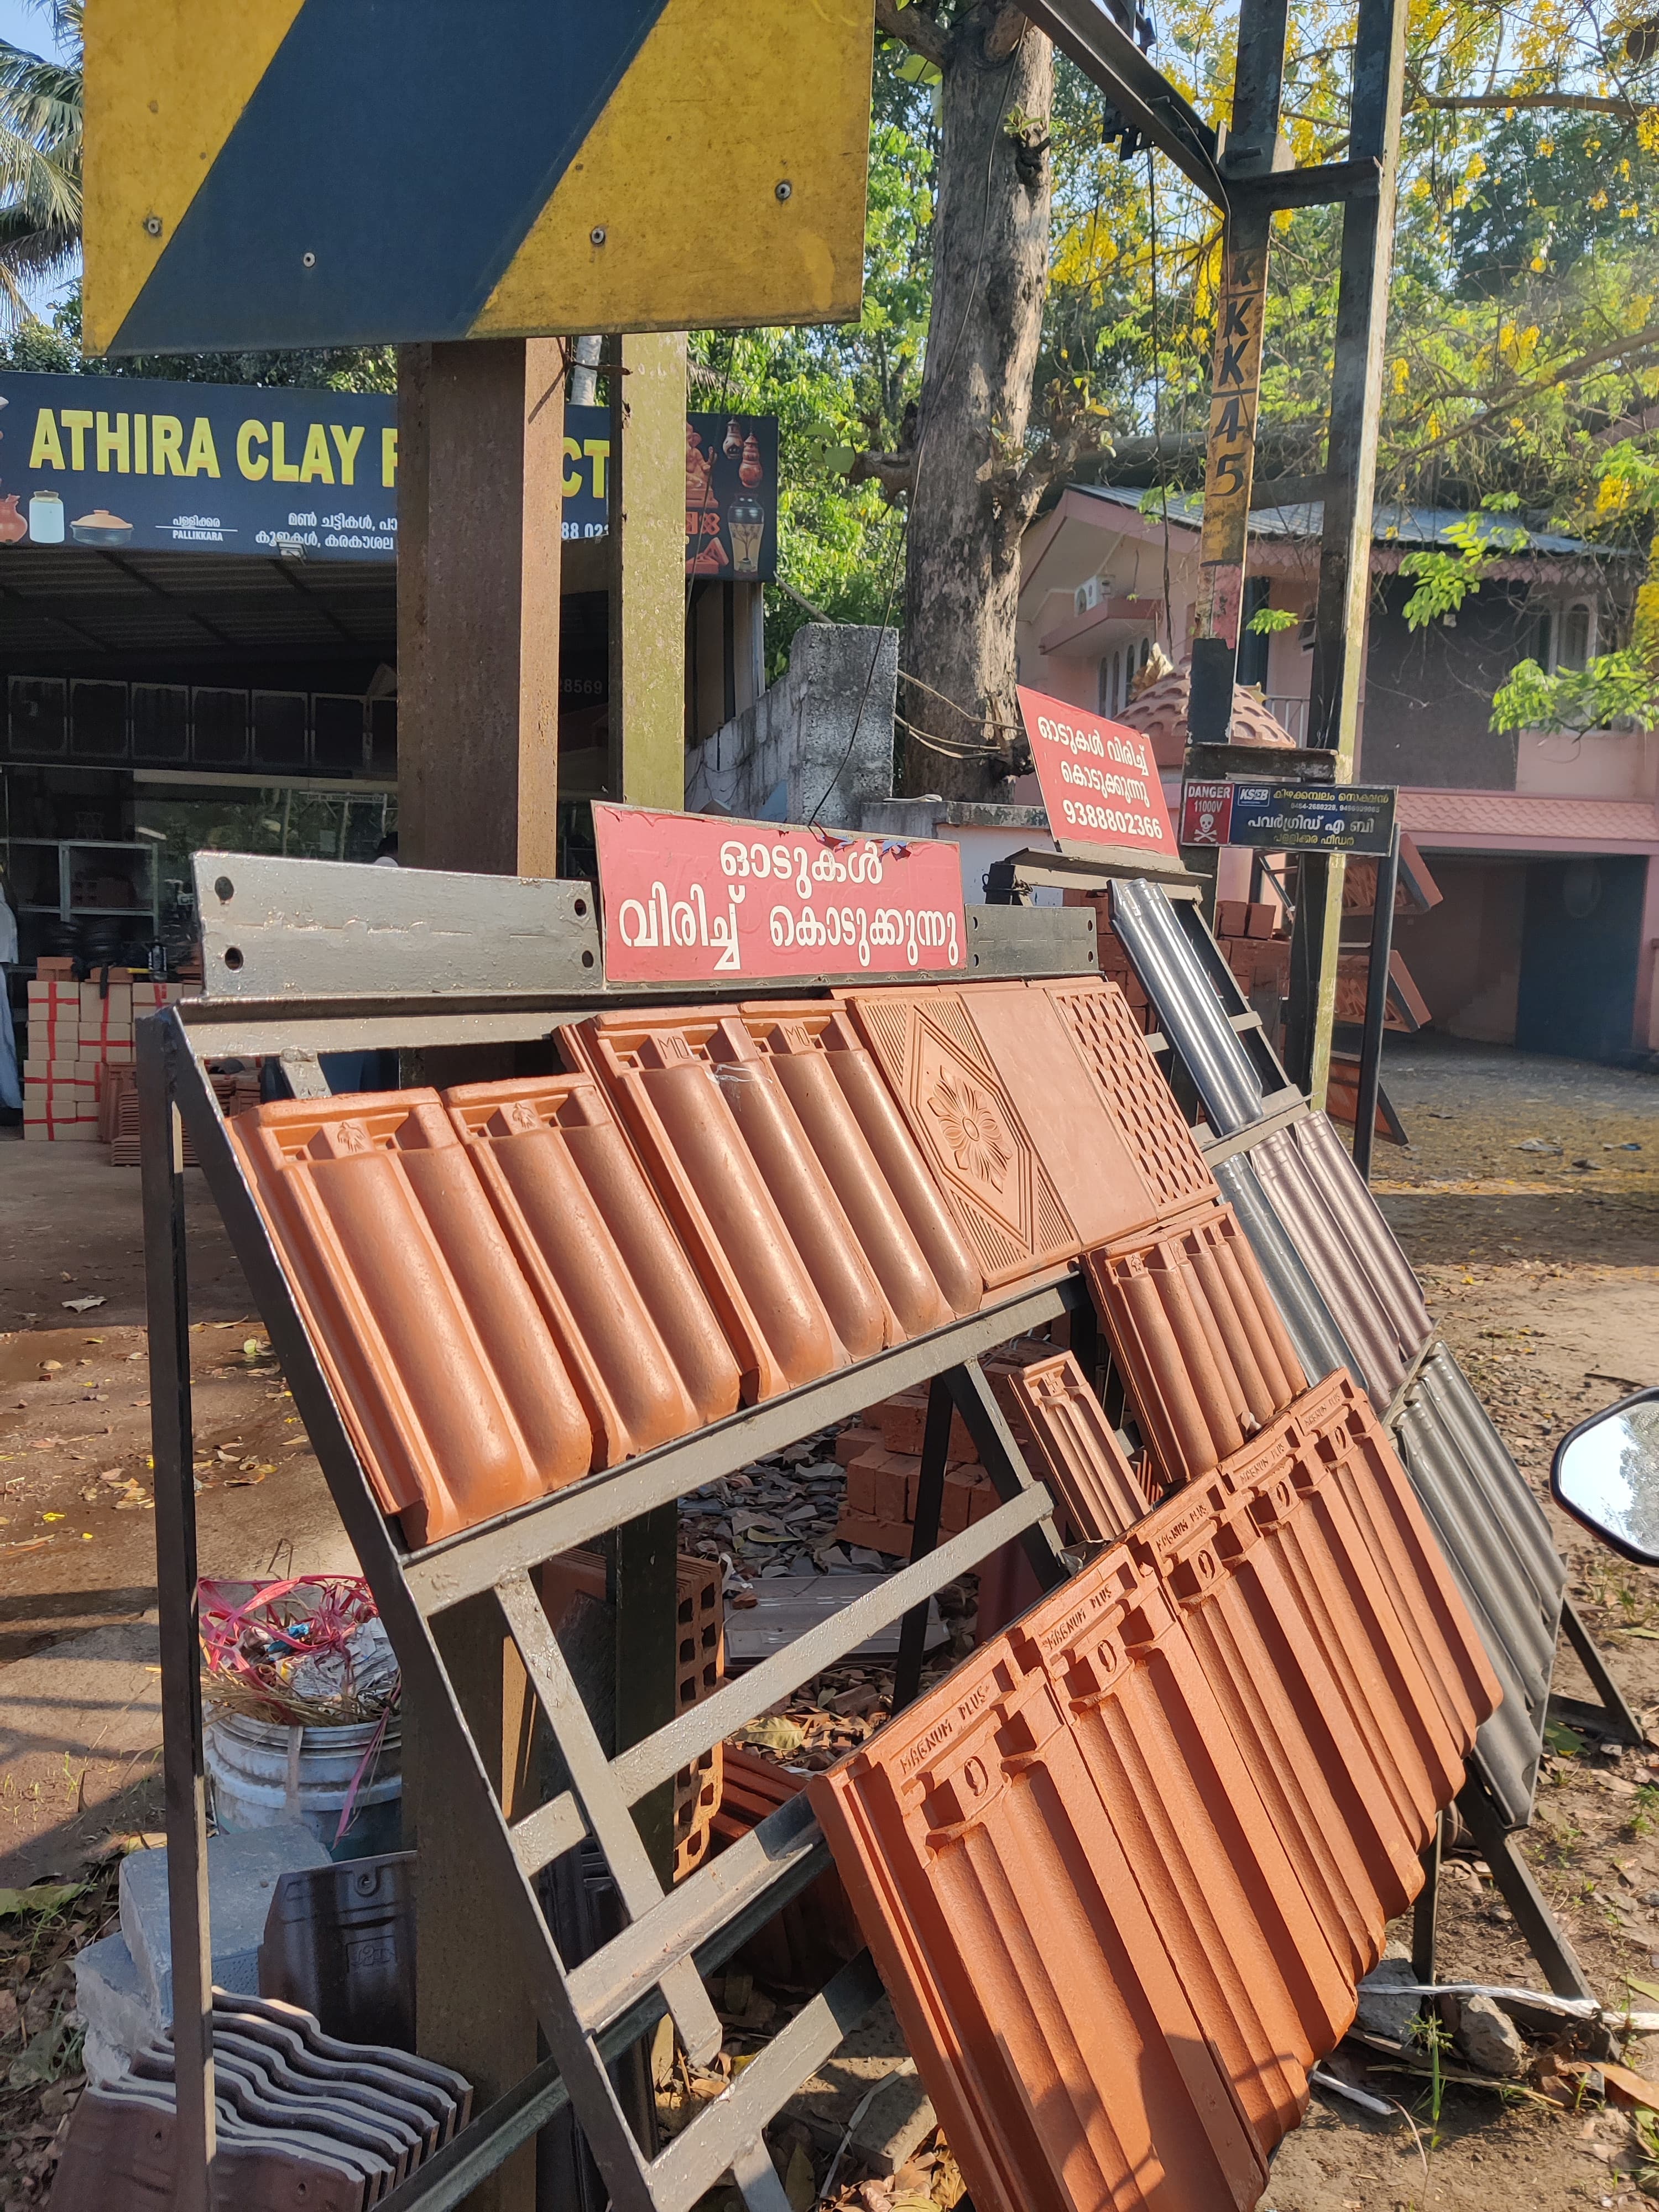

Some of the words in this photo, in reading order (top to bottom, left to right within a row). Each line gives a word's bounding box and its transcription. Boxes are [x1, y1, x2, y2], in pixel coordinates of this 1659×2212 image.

[29, 408, 221, 478] ATHIRA
[236, 419, 365, 486] CLAY
[173, 529, 223, 542] PALLIKKARA
[1038, 716, 1104, 758] ഓടുകൾ
[1107, 736, 1149, 776] വിരിച്ച്
[1061, 760, 1150, 808] കൊടുക്കുന്നു
[1188, 786, 1231, 799] DANGER
[1240, 789, 1269, 801] KSEB
[1063, 800, 1163, 839] 9388802366
[1194, 800, 1223, 813] 11000V
[1325, 819, 1345, 834] എ
[1350, 817, 1374, 833] ബി
[719, 840, 883, 900] ഓടുകൾ
[619, 881, 746, 971] വിരിച്ച്
[769, 905, 959, 967] കൊടുക്കുന്നു
[657, 1035, 689, 1060] MD
[784, 1025, 810, 1046] MD
[899, 1718, 953, 1775] MAGNUM
[957, 1685, 987, 1720] PLUS
